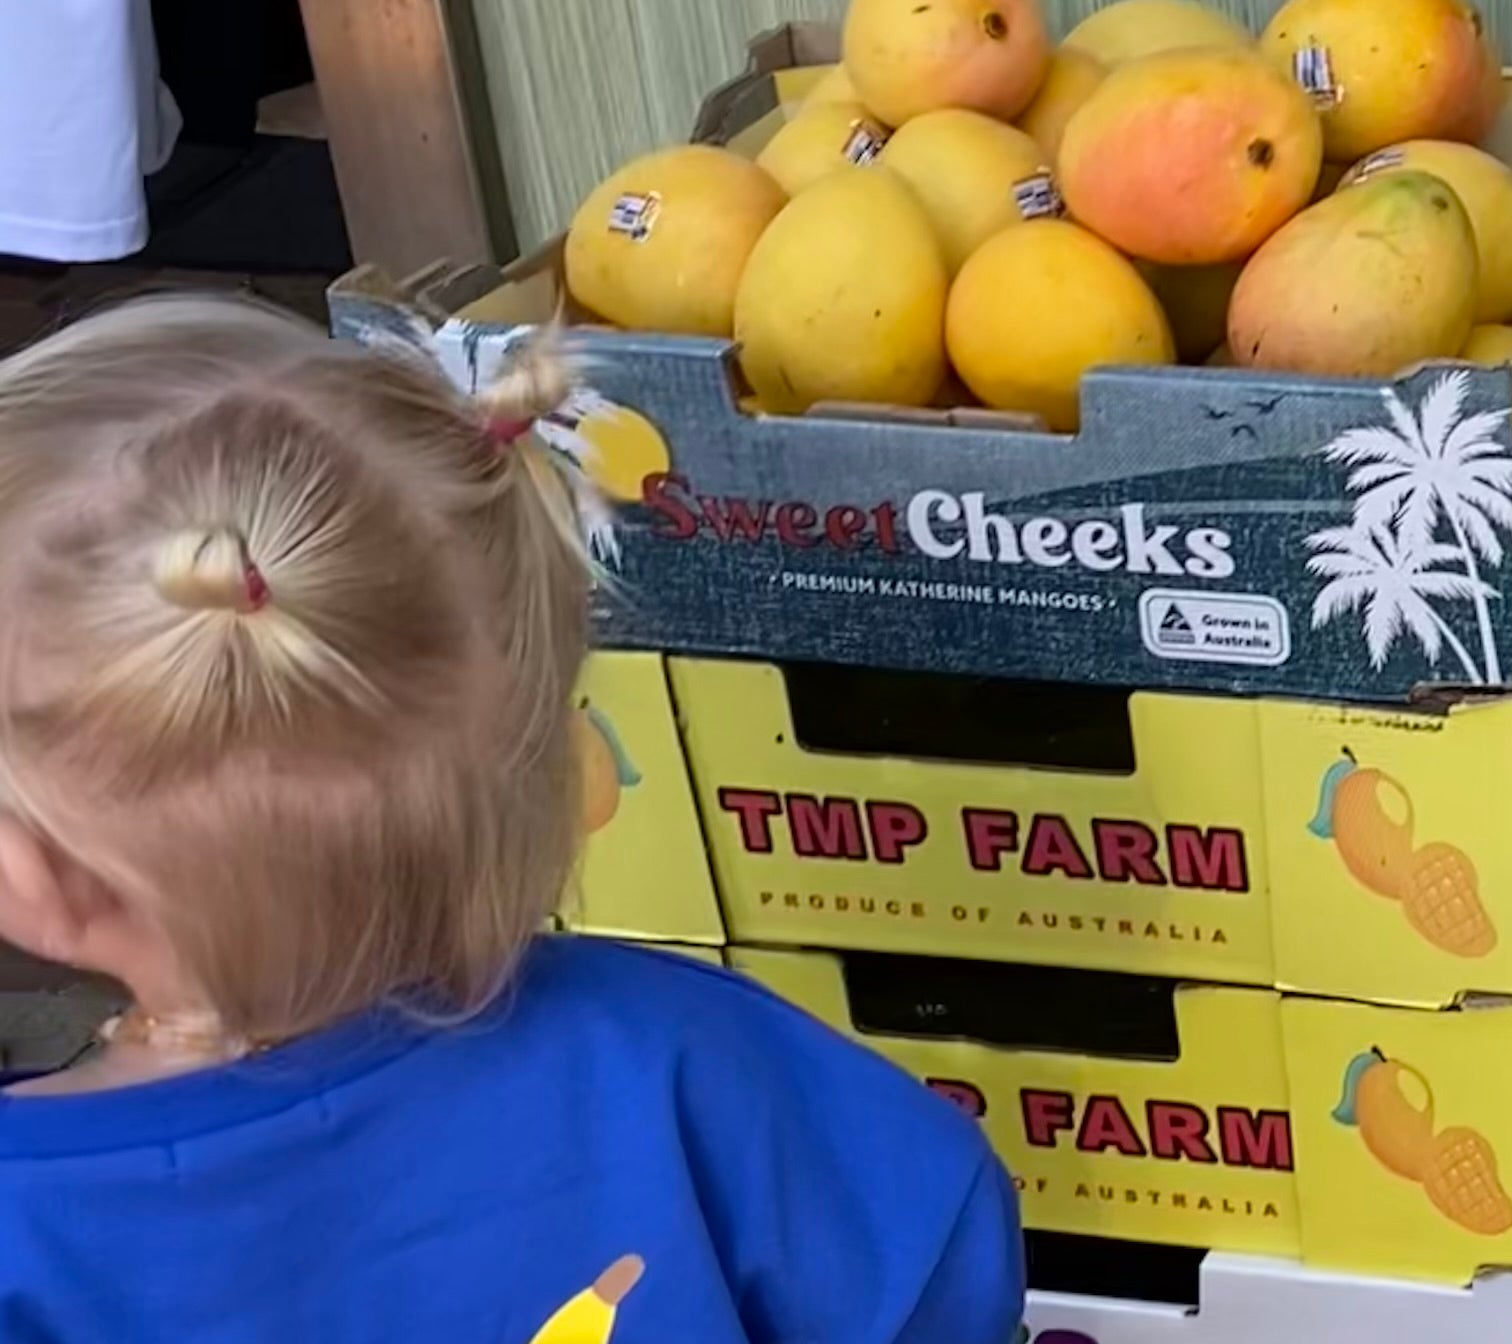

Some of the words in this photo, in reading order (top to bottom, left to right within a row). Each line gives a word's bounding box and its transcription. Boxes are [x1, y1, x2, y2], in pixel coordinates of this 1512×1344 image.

[642, 472, 899, 553] Sweet
[906, 489, 1236, 579] Cheeks
[782, 571, 875, 596] PREMIUM
[879, 578, 994, 604] KATHERINE
[998, 588, 1103, 612] MANGOES
[1202, 613, 1251, 630] Grown
[1255, 617, 1269, 631] in
[1203, 632, 1271, 649] Australia
[718, 786, 927, 864] TMP
[961, 807, 1249, 894] FARM
[760, 891, 926, 919] PRODUCE
[952, 904, 992, 924] OF
[1017, 911, 1229, 946] AUSTRALIA
[1019, 1088, 1294, 1173] FARM
[1075, 1182, 1279, 1218] AUSTRALIA
